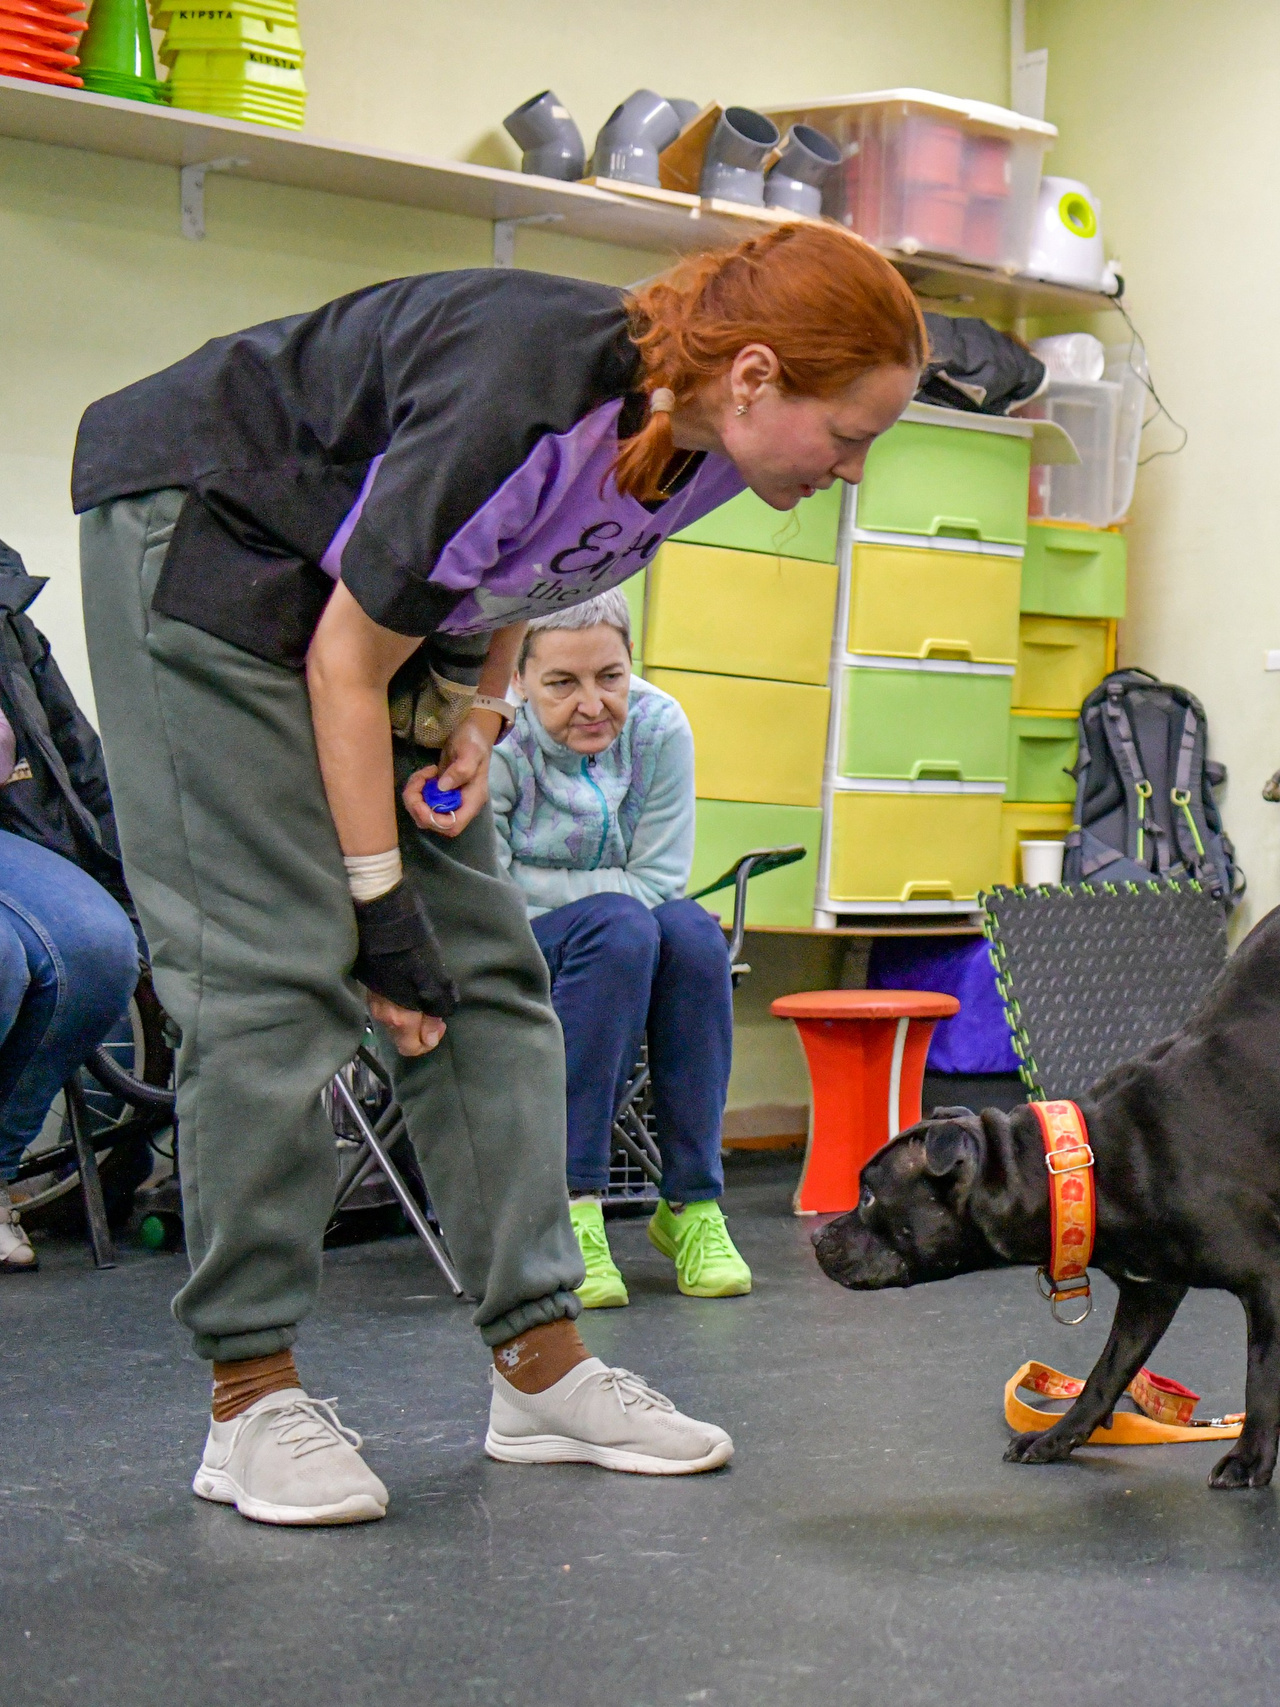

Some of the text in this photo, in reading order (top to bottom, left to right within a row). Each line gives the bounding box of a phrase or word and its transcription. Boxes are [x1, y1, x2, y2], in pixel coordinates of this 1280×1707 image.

[179, 10, 233, 20] KIPSTA
[249, 52, 297, 70] KIPSTA
[526, 579, 580, 601] the
